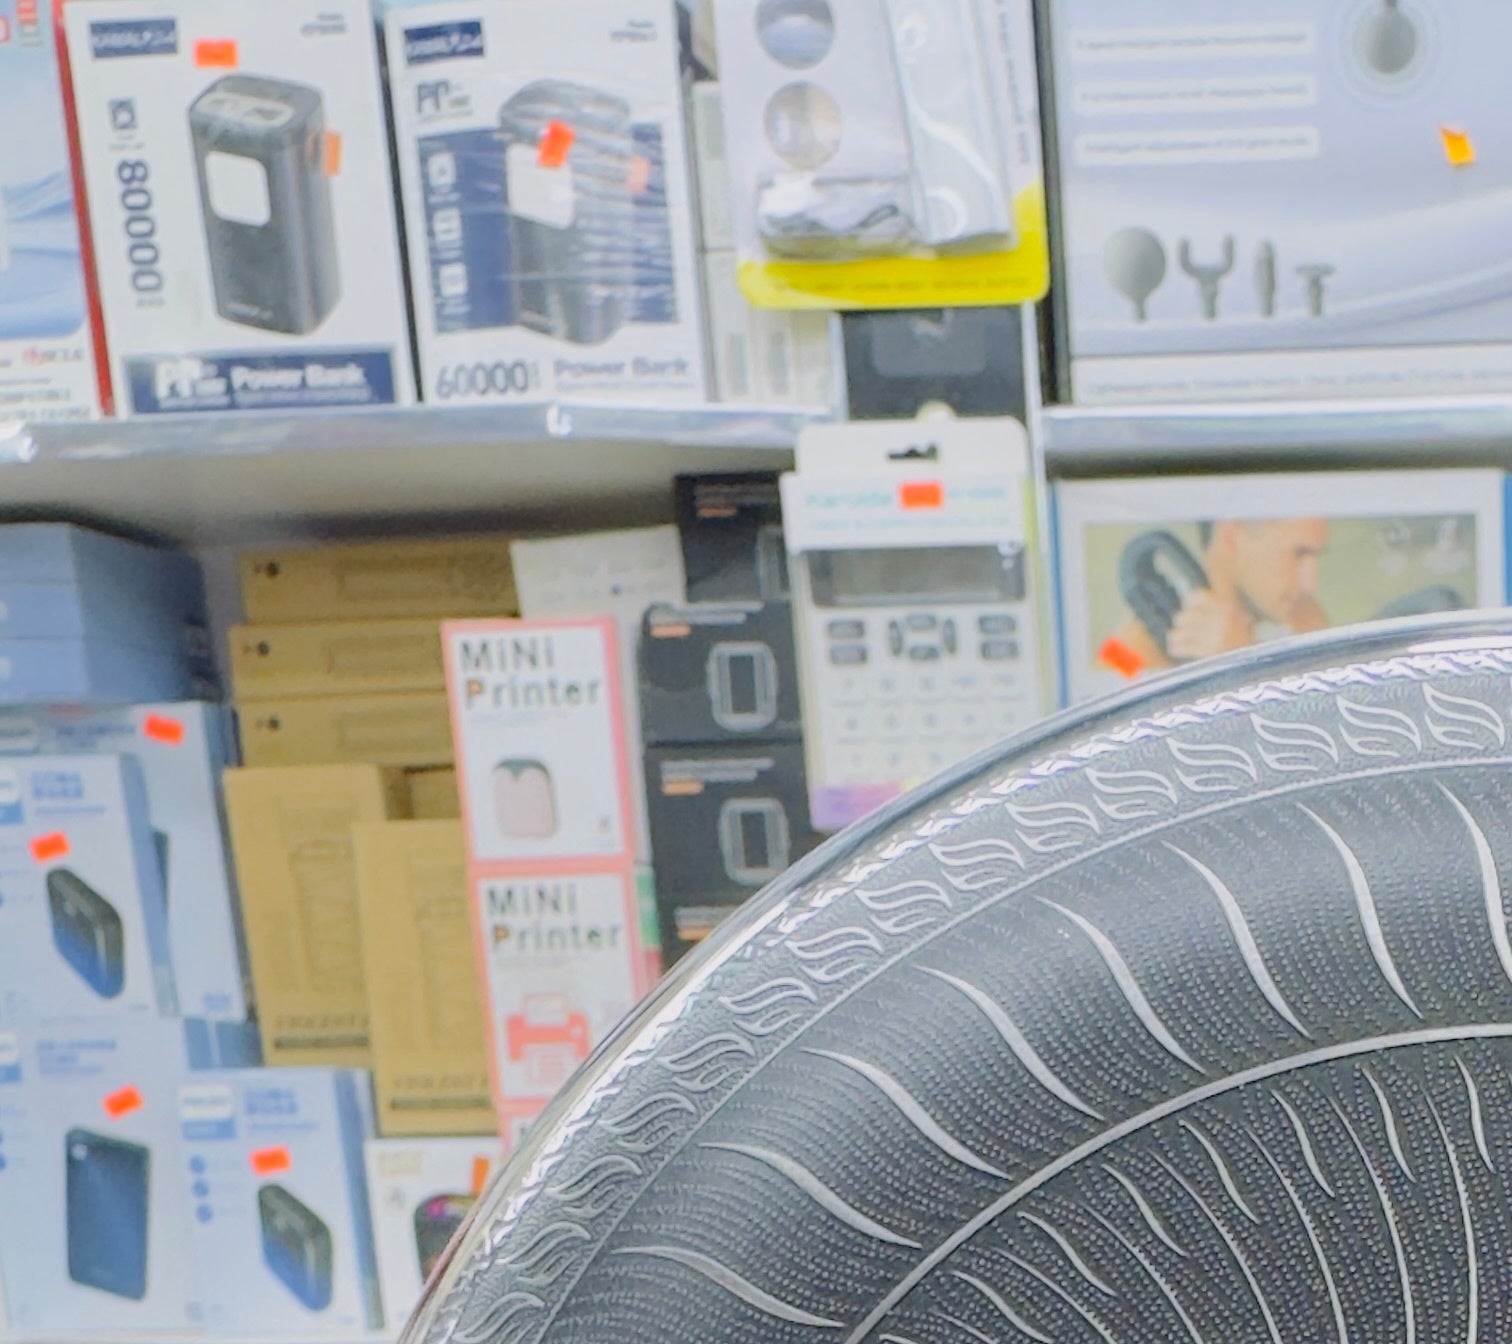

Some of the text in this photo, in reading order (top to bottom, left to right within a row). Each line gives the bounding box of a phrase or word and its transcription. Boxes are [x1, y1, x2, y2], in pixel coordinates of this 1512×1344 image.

[117, 158, 163, 292] 80000
[231, 366, 302, 391] Power
[304, 363, 365, 388] Bank
[436, 360, 530, 398] 60000
[464, 676, 602, 709] Printer
[493, 921, 621, 955] Printer
